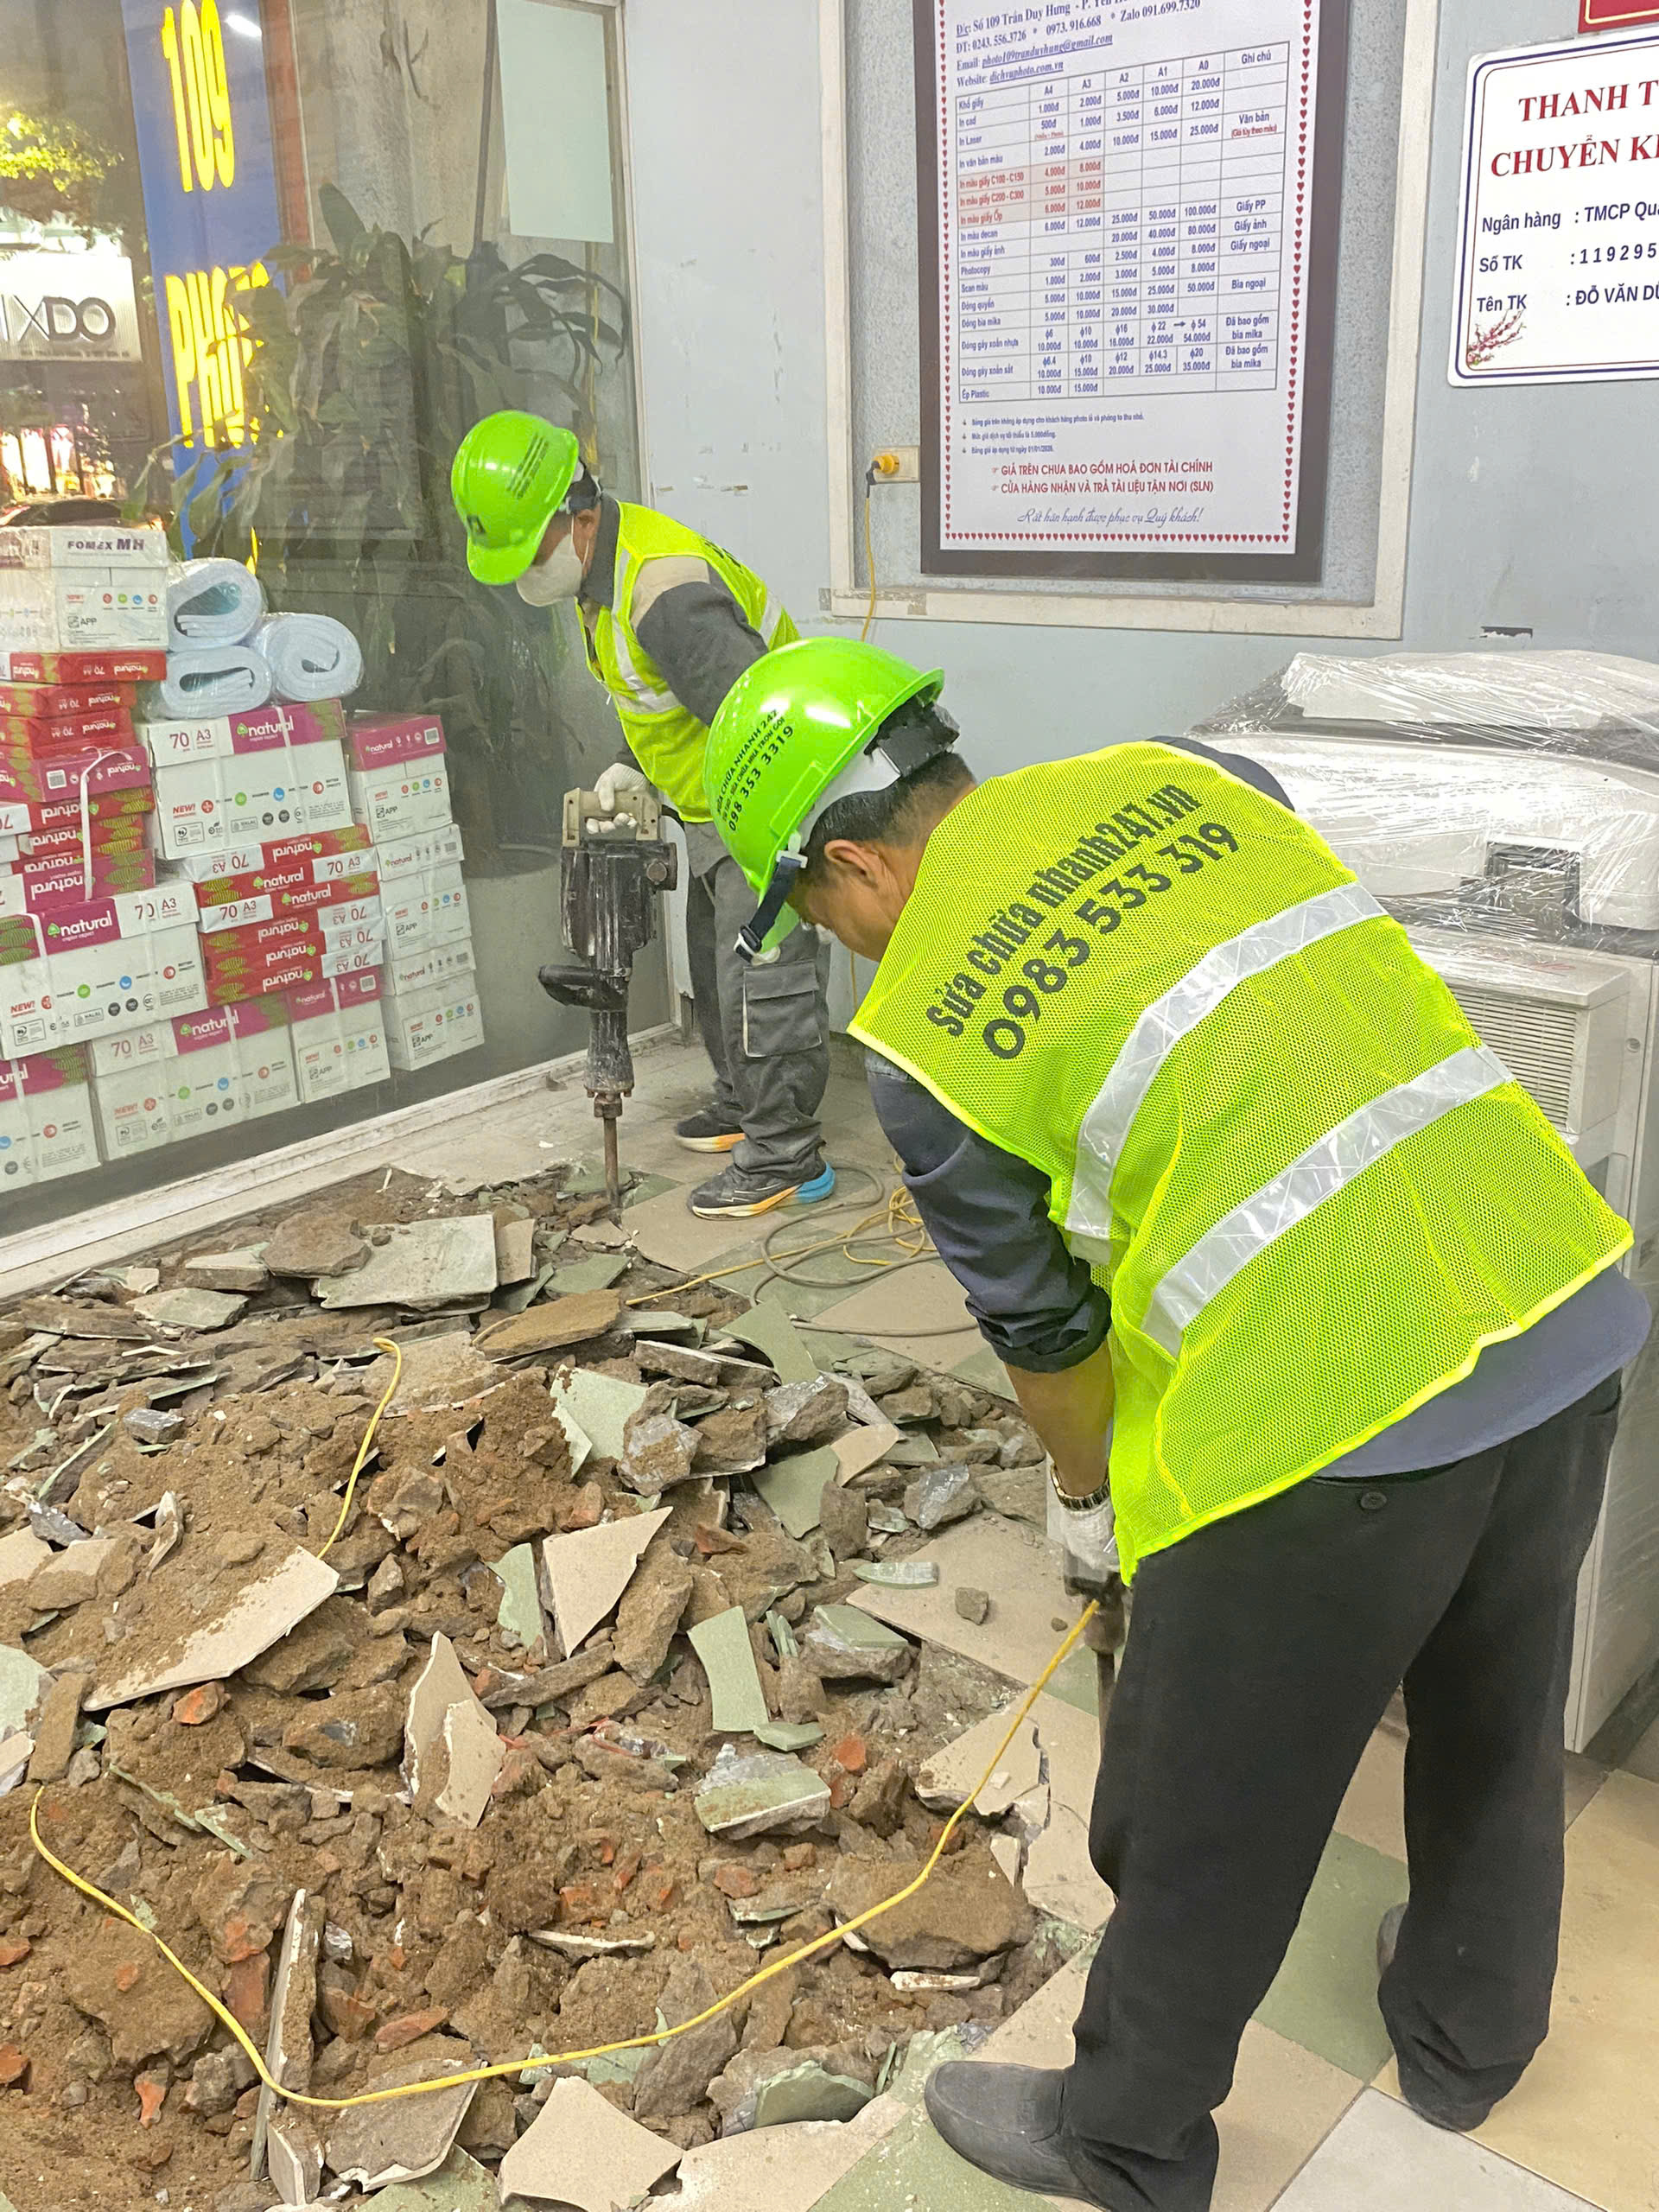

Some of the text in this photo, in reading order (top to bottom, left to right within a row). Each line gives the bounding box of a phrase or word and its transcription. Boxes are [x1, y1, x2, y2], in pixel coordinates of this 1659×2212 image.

[986, 16, 1000, 29] 109
[1026, 8, 1043, 21] Duy
[1120, 8, 1140, 22] Zalo
[1044, 86, 1053, 95] A4
[1082, 79, 1091, 89] A3
[1119, 73, 1128, 83] A2
[1158, 67, 1167, 77] A1
[1198, 60, 1209, 71] A0
[1241, 53, 1255, 65] Ghi
[162, 0, 235, 192] 109
[1518, 83, 1630, 122] THANH
[1255, 199, 1266, 210] PP
[1482, 214, 1520, 235] Ngân
[1524, 211, 1561, 230] hàng
[1584, 203, 1630, 222] TMCP
[1478, 254, 1499, 273] Số
[1503, 253, 1523, 270] TK
[1477, 296, 1503, 313] Tên
[1507, 294, 1528, 310] TK
[1575, 284, 1599, 306] ĐỖ
[1604, 283, 1639, 303] VĂN
[1001, 462, 1017, 475] GIÁ
[1019, 462, 1039, 475] TRÊN
[1068, 464, 1087, 474] BAO
[1116, 459, 1136, 474] HOÁ
[1164, 458, 1179, 474] TÀI
[1181, 457, 1213, 474] CHÍNH
[1021, 480, 1048, 493] HÀNG
[1077, 478, 1091, 493] VÀ
[1111, 478, 1125, 493] TÀI
[1190, 480, 1214, 493] (SLN)
[67, 538, 145, 551] FOMEX MH
[80, 617, 98, 626] APP
[248, 715, 295, 737] natural
[169, 728, 212, 749] 70 A3
[734, 728, 762, 766] NHANH
[728, 800, 743, 831] 098
[740, 767, 761, 798] 353
[761, 725, 794, 766] 3319
[172, 803, 196, 815] NEW!
[272, 842, 312, 863] natural
[391, 853, 412, 867] natural
[213, 854, 250, 874] 70 A3
[327, 855, 361, 875] 70 A3
[30, 874, 84, 901] natural
[263, 867, 304, 888] natural
[162, 898, 177, 911] A3
[290, 883, 332, 906] natural
[219, 899, 257, 921] 70 A3
[333, 905, 367, 925] 70 A3
[926, 784, 1204, 1037] Sửa chữa nhanh247.vn
[60, 910, 113, 938] natural
[257, 920, 299, 944] natural
[339, 928, 374, 949] 70 A3
[982, 822, 1239, 1059] 0983 533 319
[266, 944, 307, 968] natural
[336, 952, 371, 973] 70 A3
[263, 969, 303, 992] natural
[10, 1000, 35, 1014] NEW!
[111, 1033, 155, 1058] 70 A3
